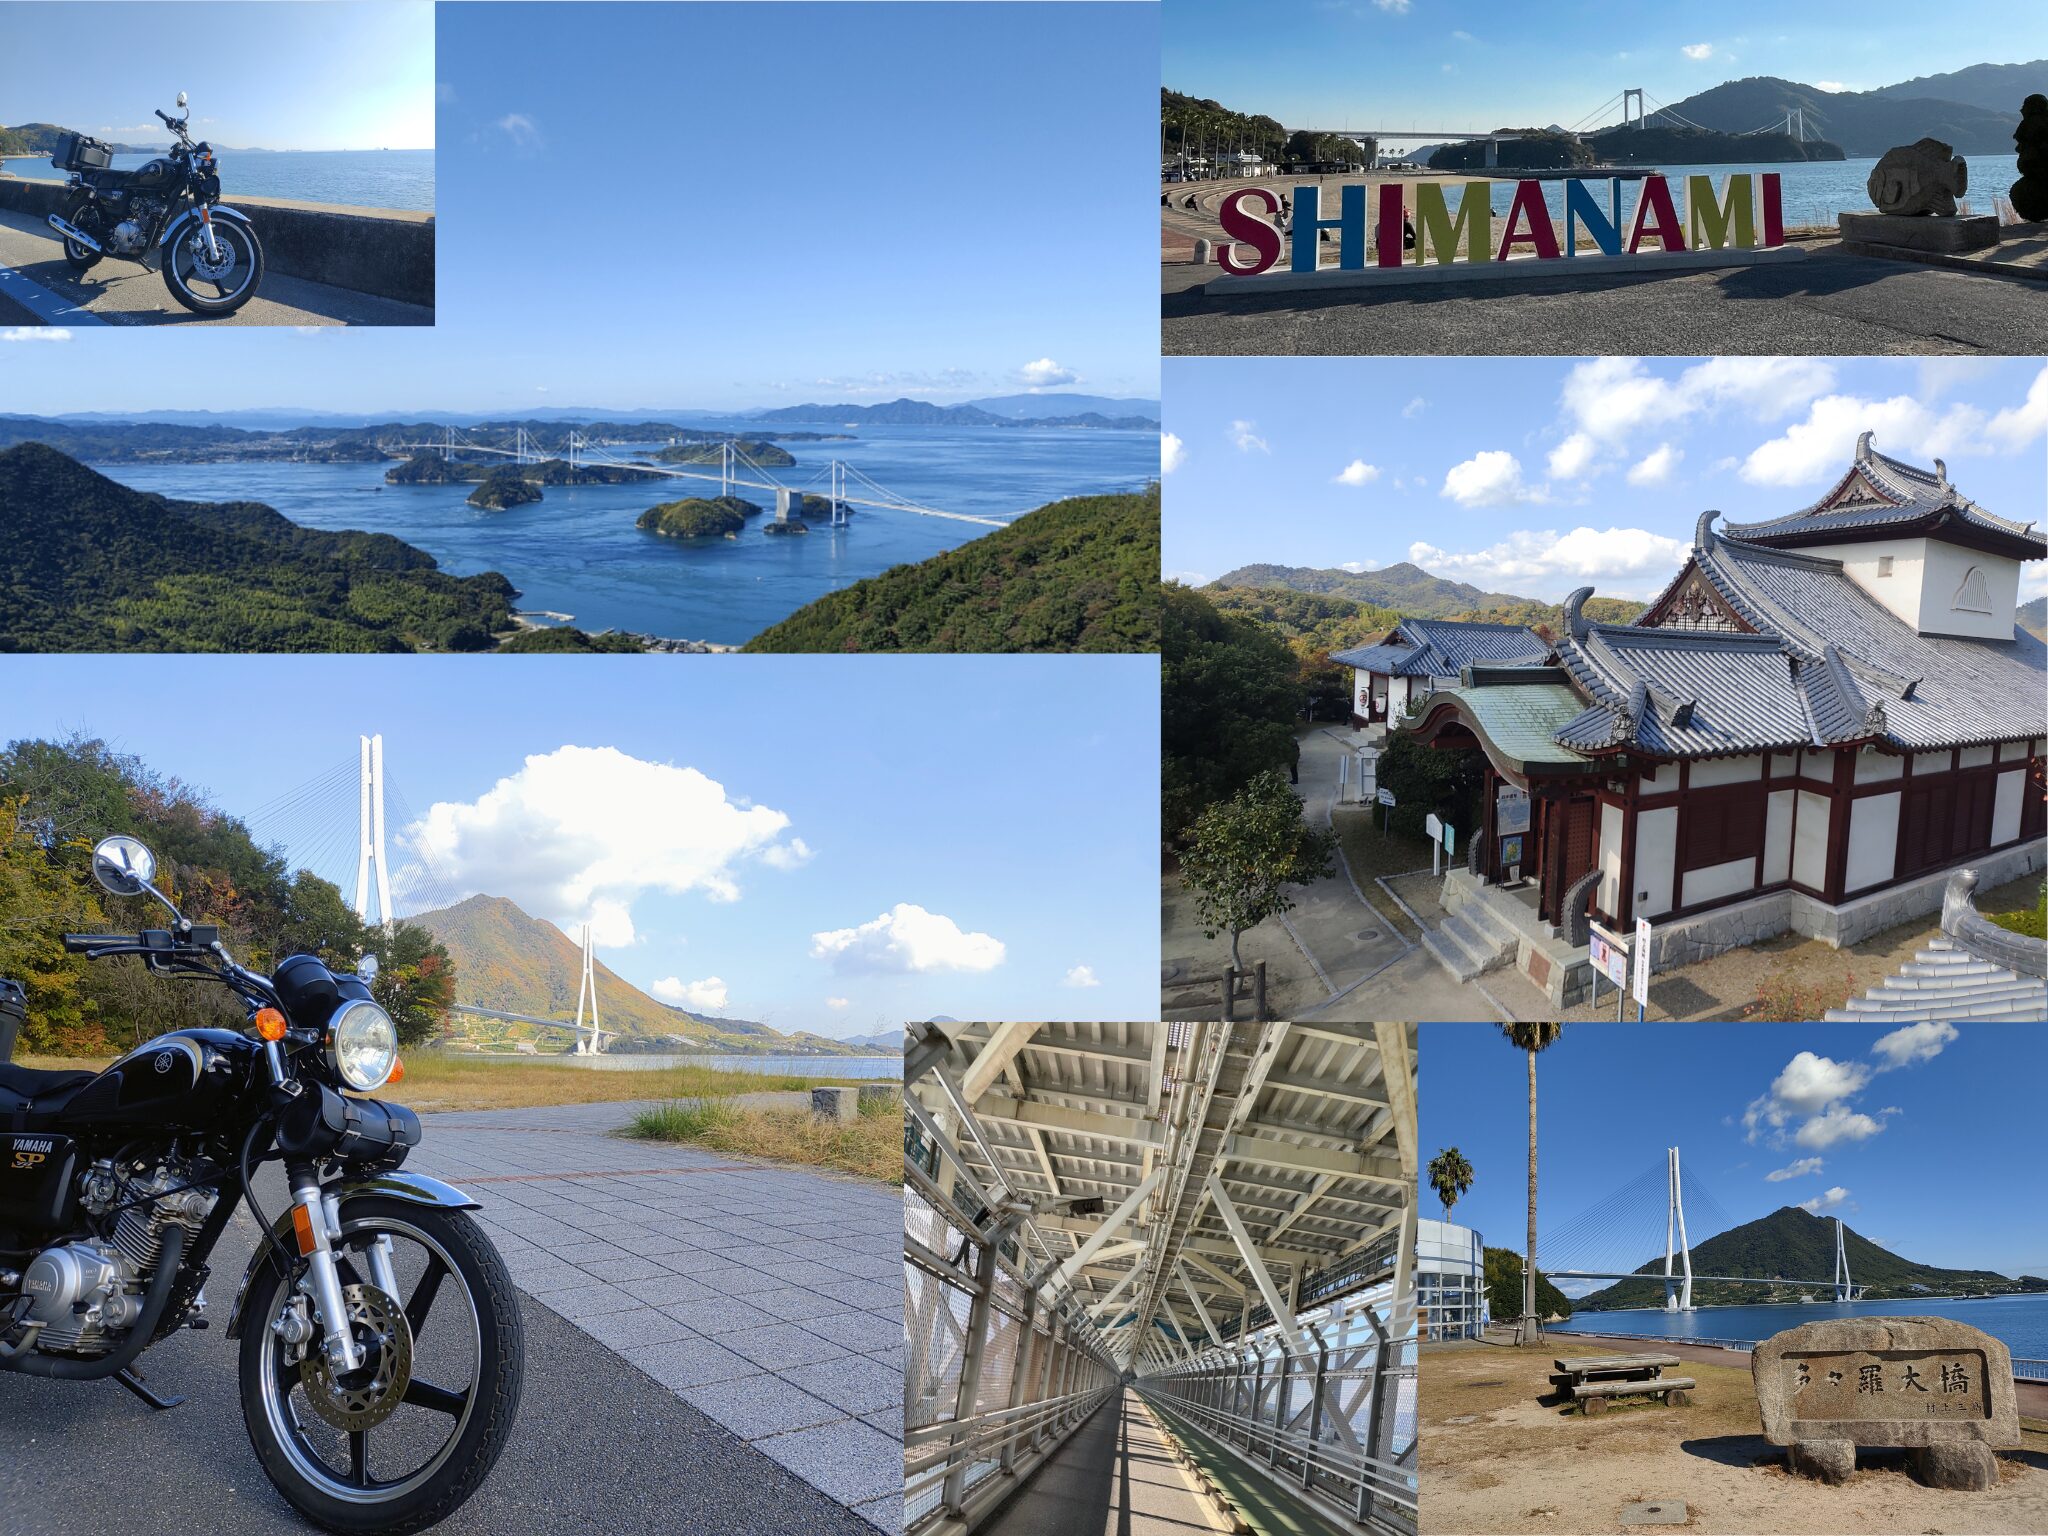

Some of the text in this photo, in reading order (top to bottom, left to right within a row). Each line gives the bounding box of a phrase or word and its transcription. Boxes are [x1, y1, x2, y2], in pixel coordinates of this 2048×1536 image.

[1217, 172, 1785, 275] SHIMANAMI
[12, 1138, 53, 1153] YAMAHA
[1793, 1363, 1971, 1396] 多々羅大橋
